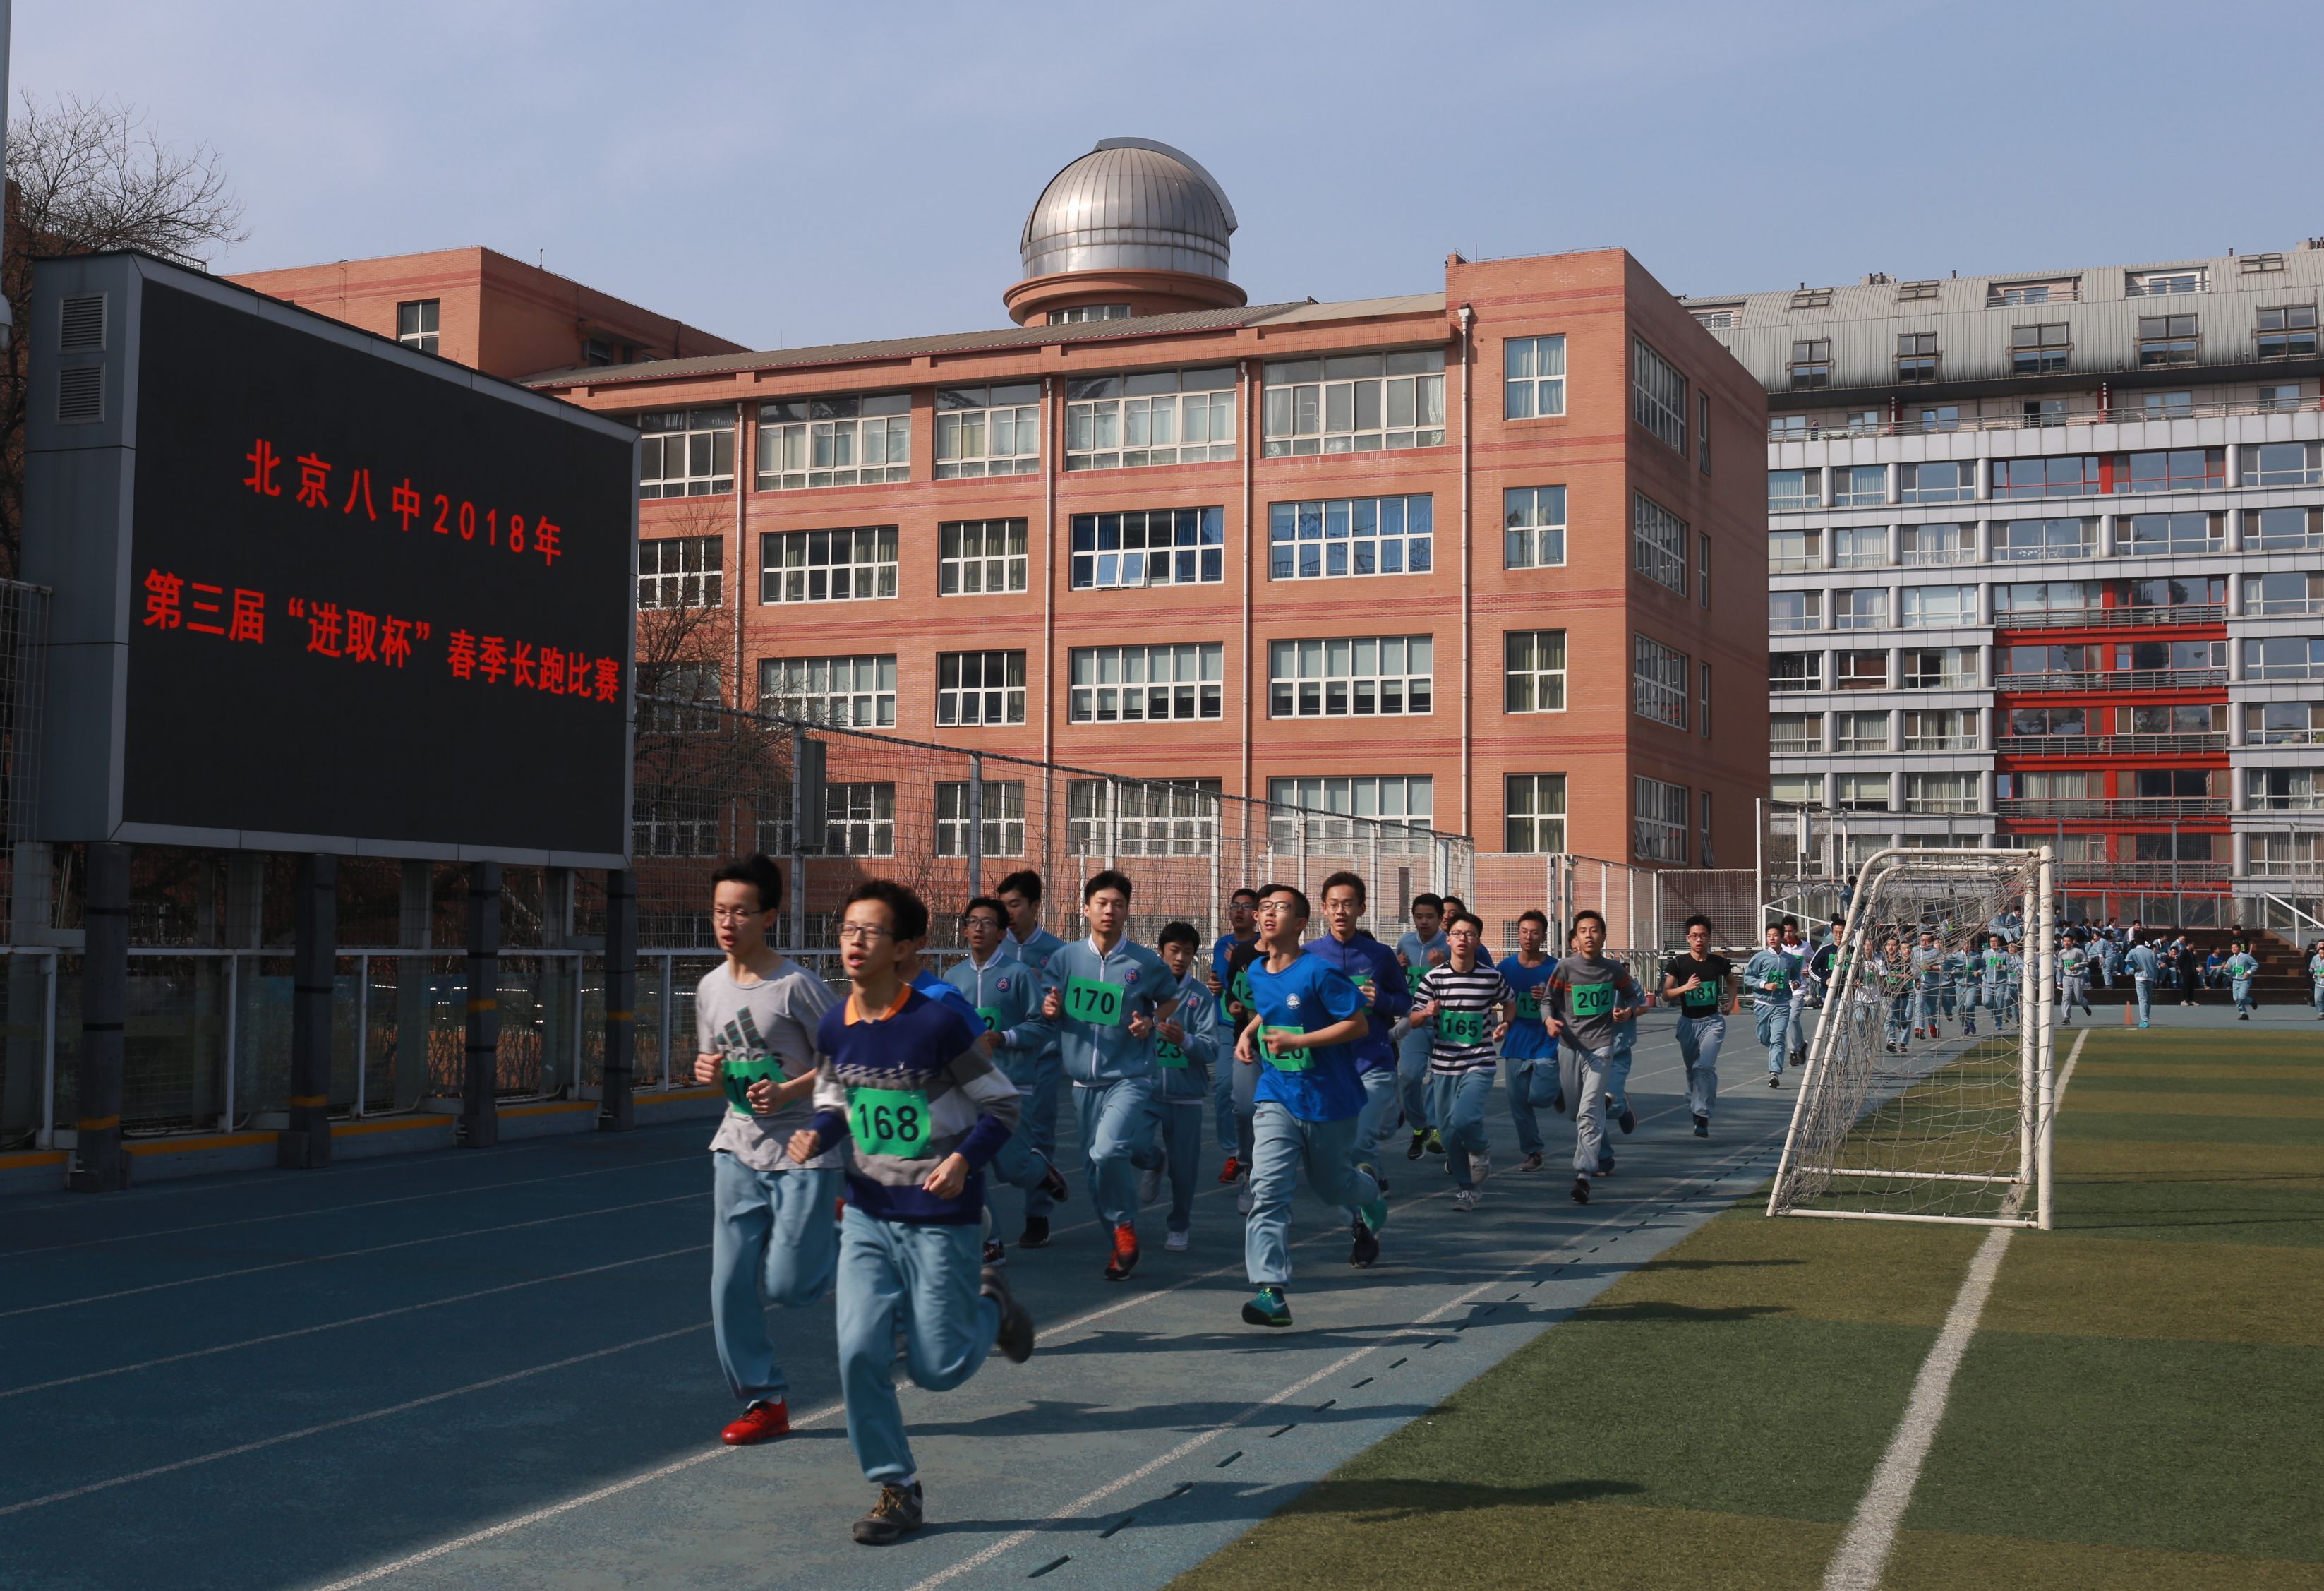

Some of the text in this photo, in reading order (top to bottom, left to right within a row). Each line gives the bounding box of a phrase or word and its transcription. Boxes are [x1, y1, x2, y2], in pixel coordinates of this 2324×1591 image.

[244, 439, 562, 565] 北京八中2018年
[1073, 987, 1115, 1015] 170
[1577, 989, 1610, 1009] 202
[1690, 986, 1714, 1000] 181
[1444, 1018, 1479, 1038] 165
[858, 1103, 920, 1142] 168
